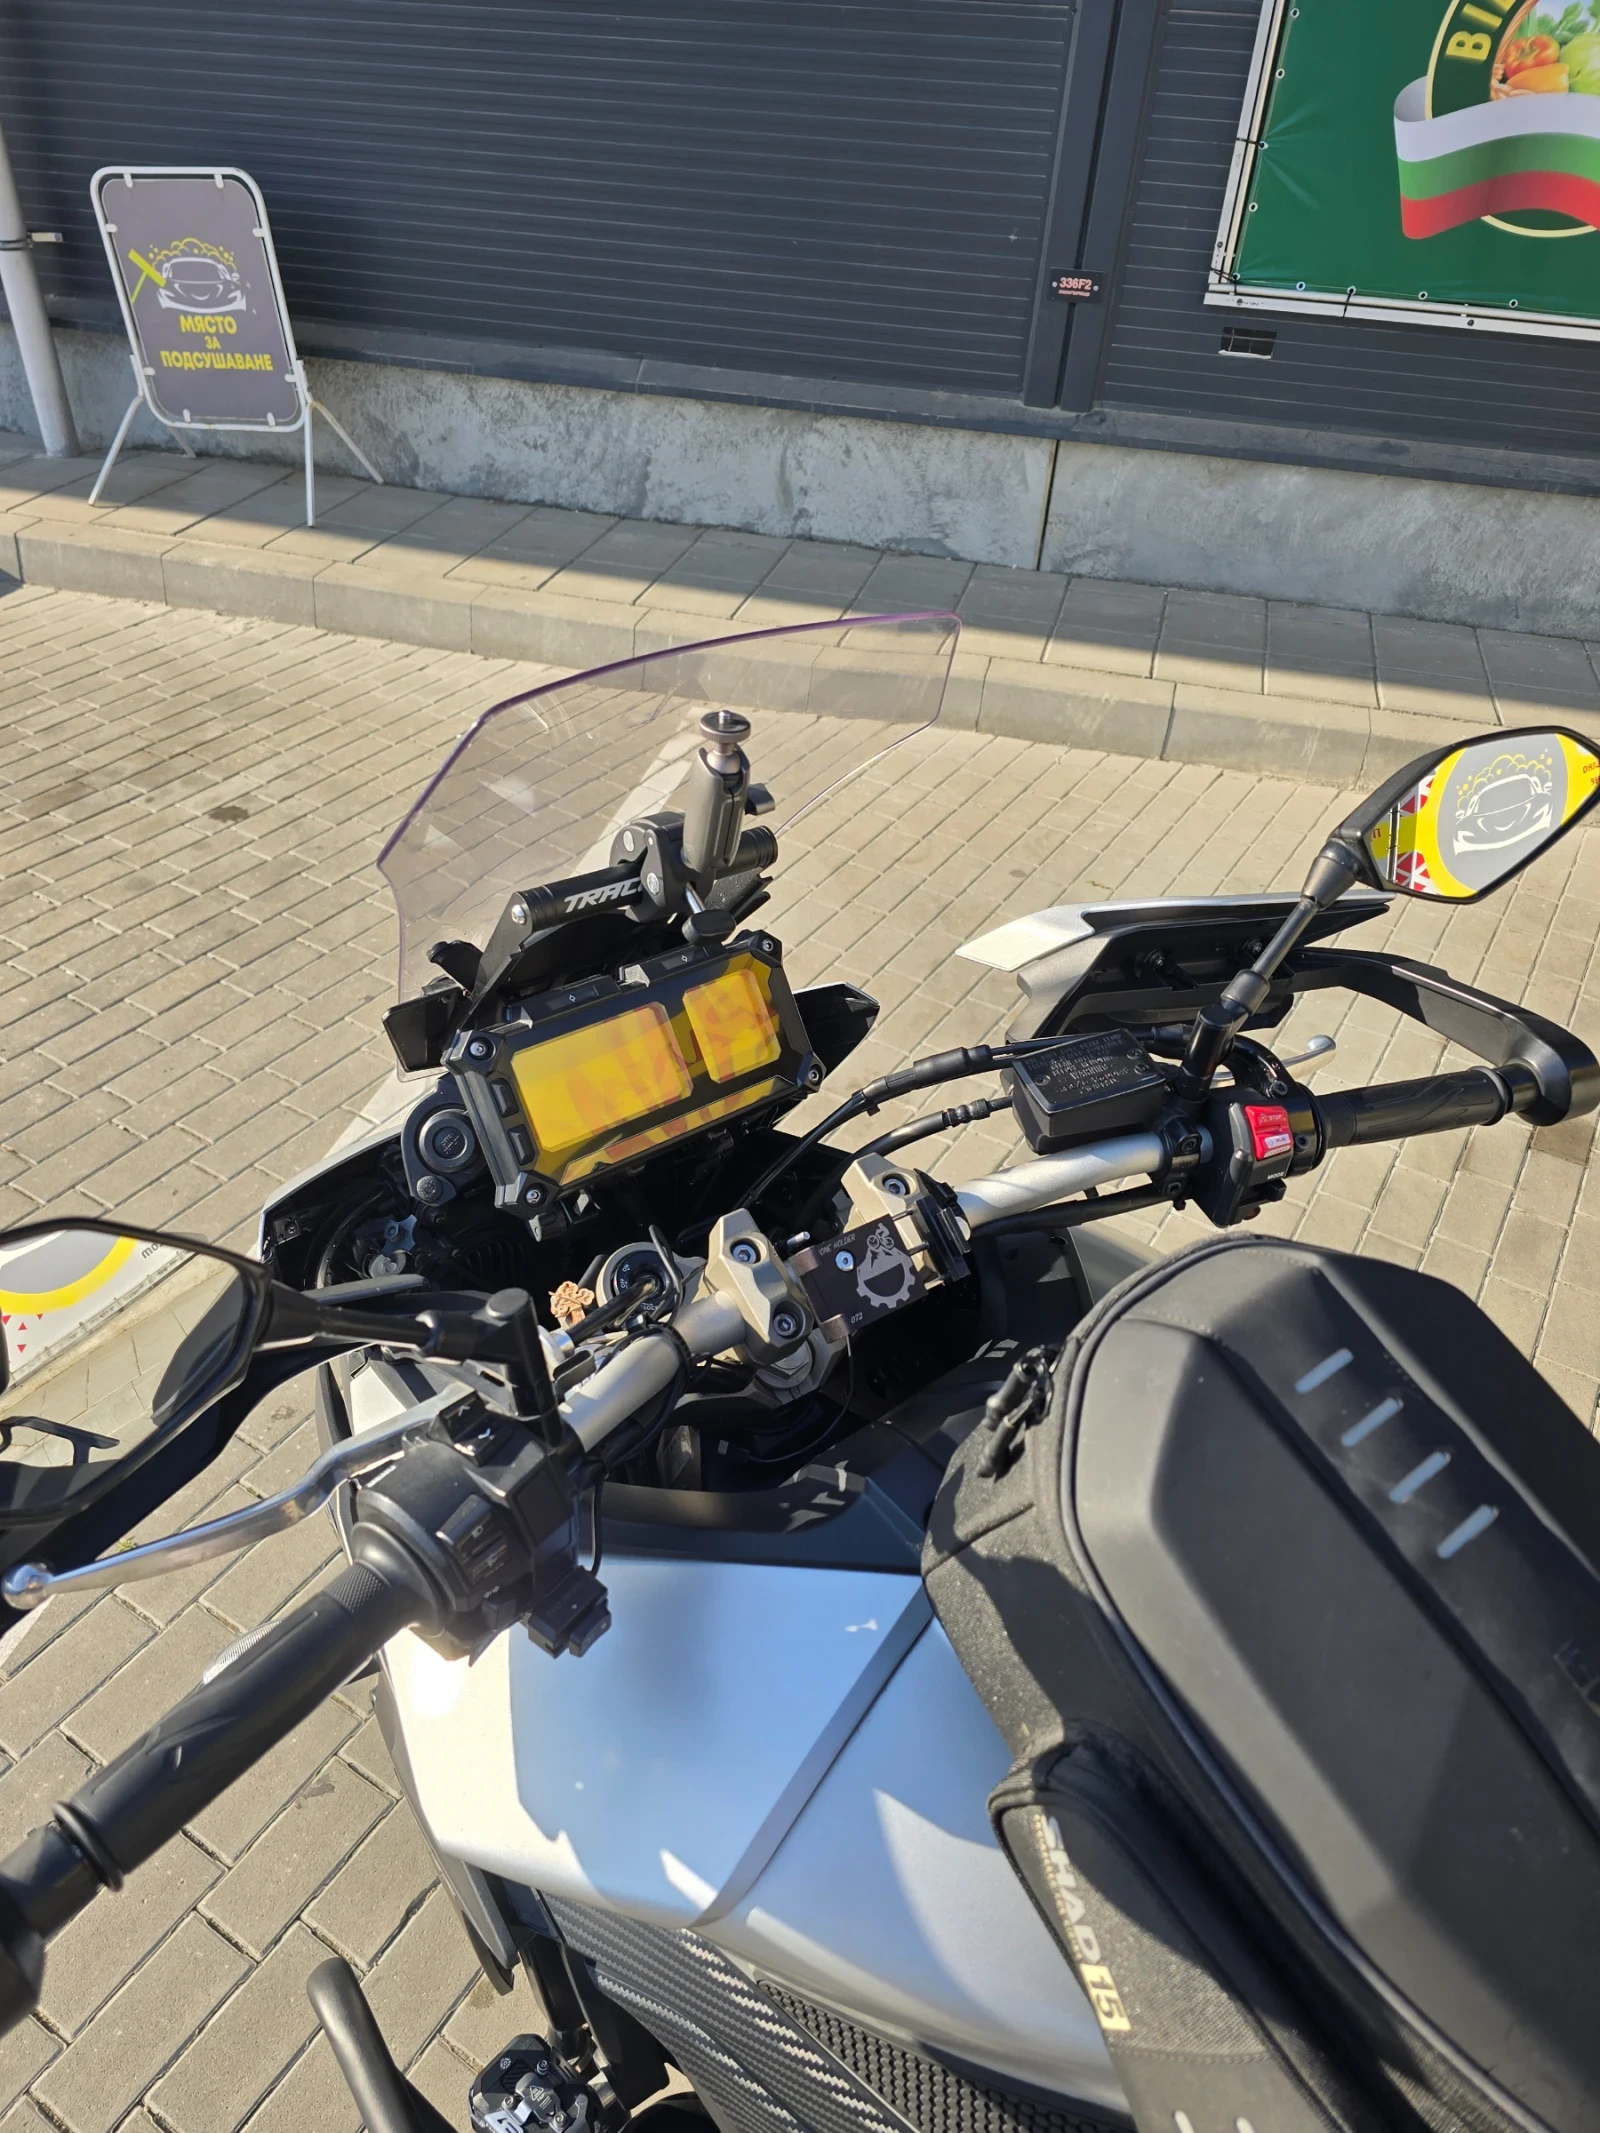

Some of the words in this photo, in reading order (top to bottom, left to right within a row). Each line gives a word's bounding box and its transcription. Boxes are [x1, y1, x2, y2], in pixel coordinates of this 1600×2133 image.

[1059, 277, 1092, 290] 336F2
[179, 315, 237, 334] МЯСТО
[204, 336, 221, 349] ЗА
[160, 350, 273, 371] ПОДСУШАВАНЕ
[1267, 1171, 1285, 1180] MODE
[833, 1234, 856, 1249] HOLDER
[1042, 1814, 1101, 1963] SHAD
[1085, 1970, 1127, 2024] 15
